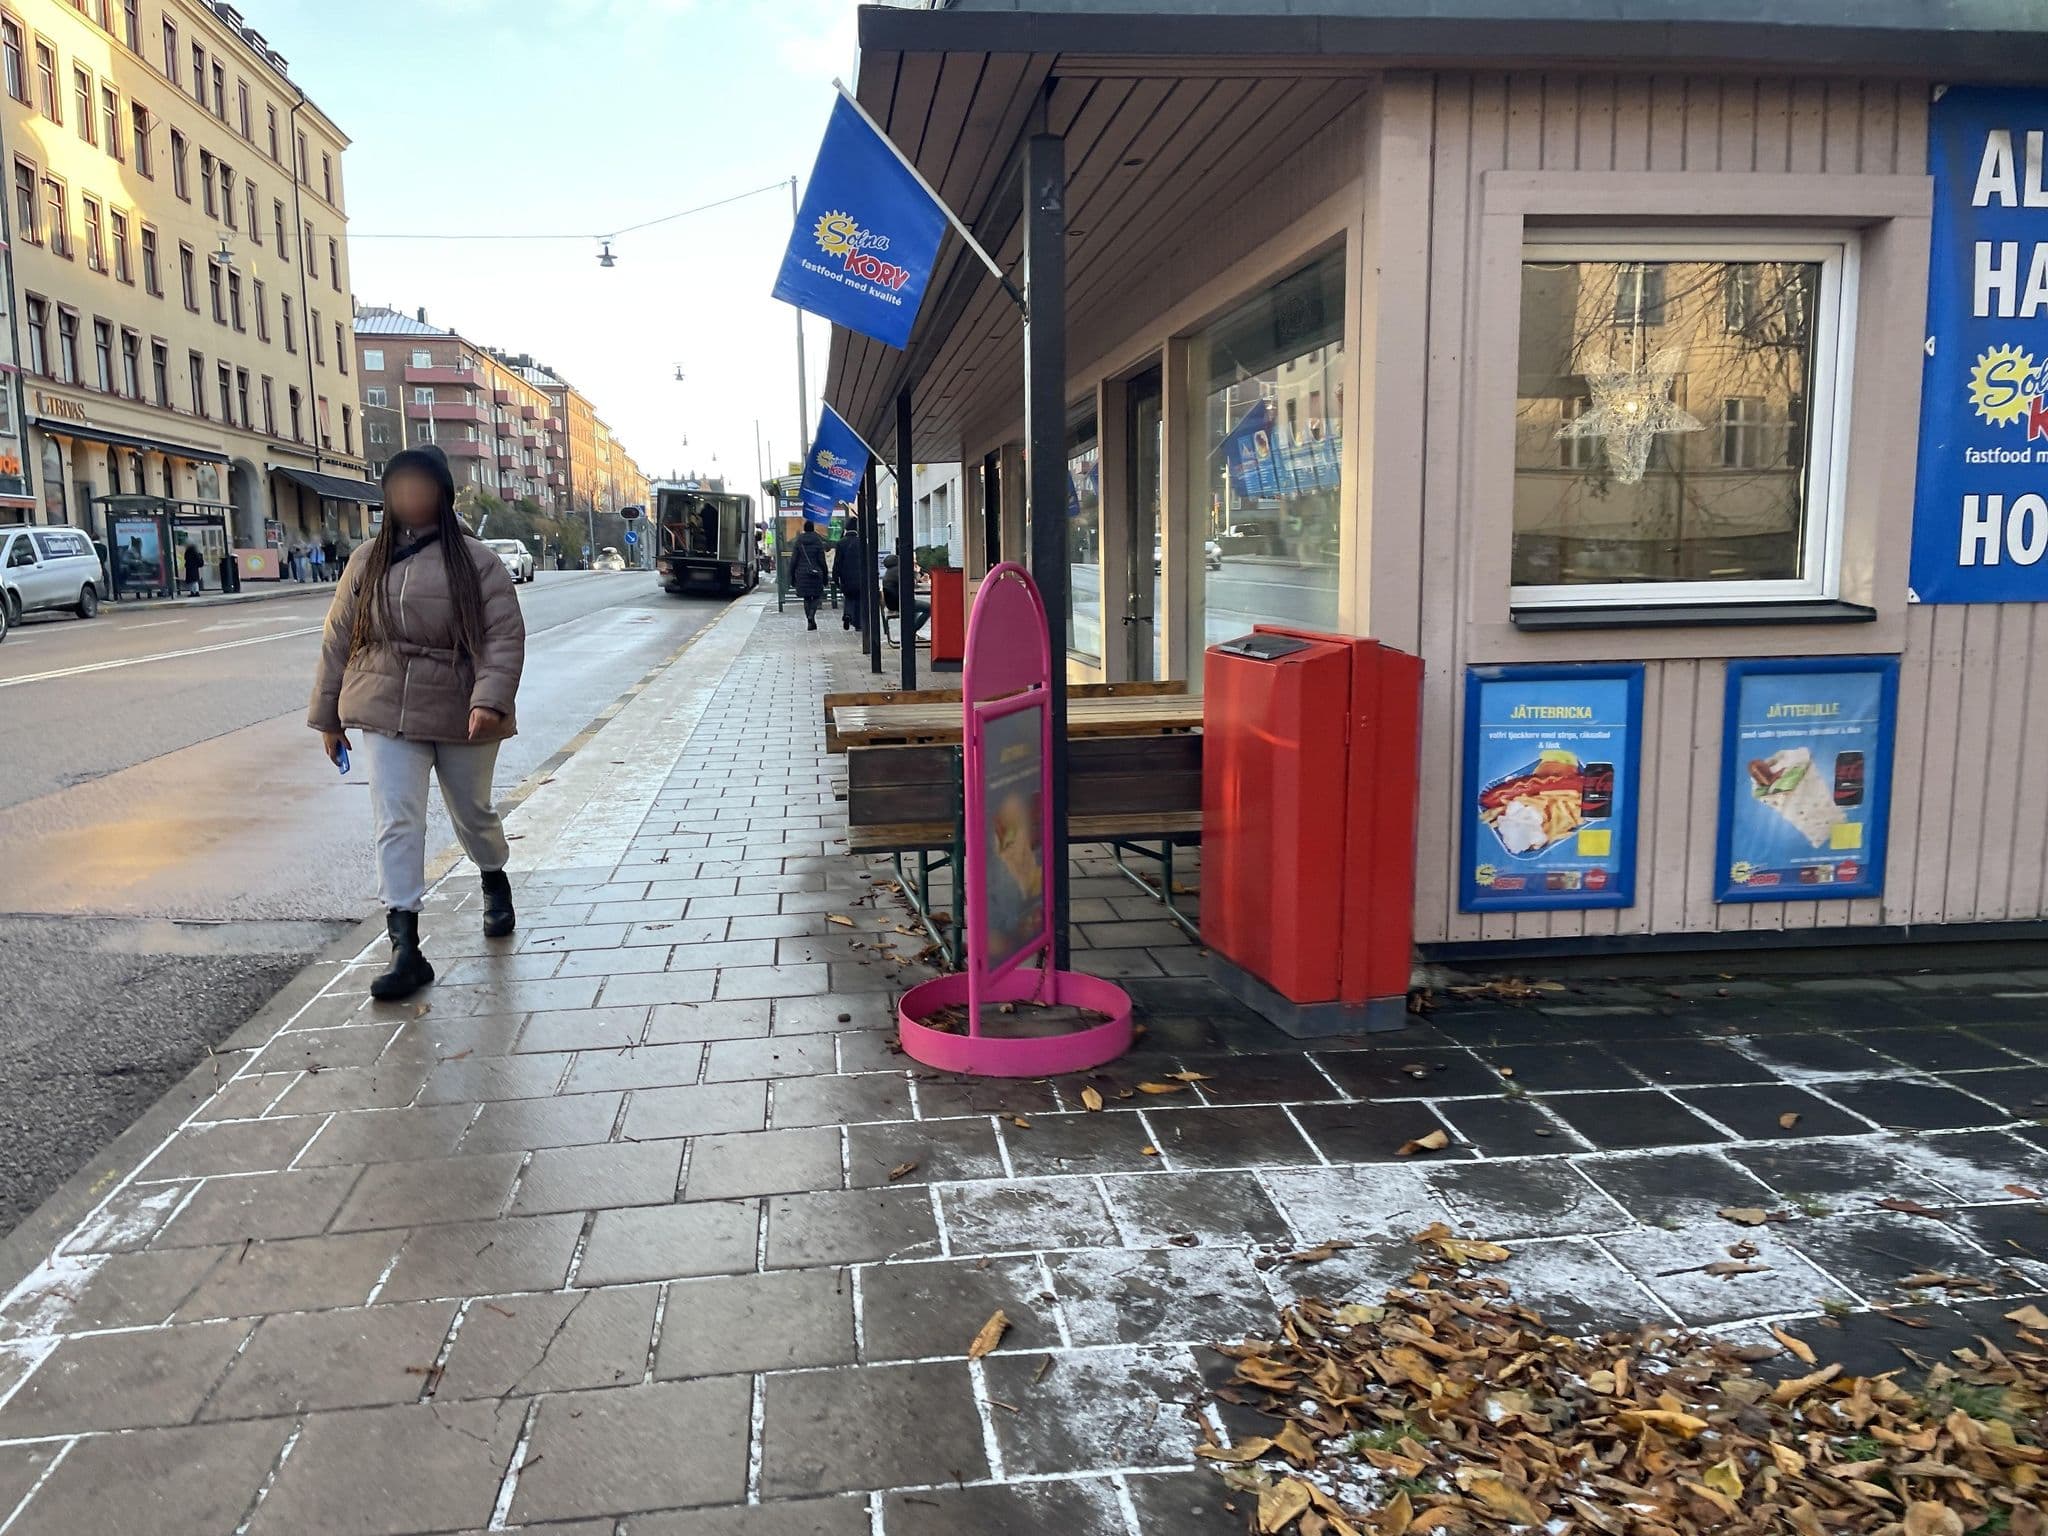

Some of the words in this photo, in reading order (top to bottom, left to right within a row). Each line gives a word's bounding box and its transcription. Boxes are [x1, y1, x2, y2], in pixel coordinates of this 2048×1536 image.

[1971, 128, 2048, 208] AL
[822, 219, 890, 251] Solna
[801, 258, 844, 282] fastfood
[844, 276, 867, 292] med
[869, 285, 903, 306] kvalité
[844, 247, 910, 291] KORV
[1973, 241, 2048, 318] HA
[1964, 447, 2032, 463] fastfood
[1959, 493, 2048, 566] HO
[1510, 704, 1592, 719] JÄTTEBRICKA
